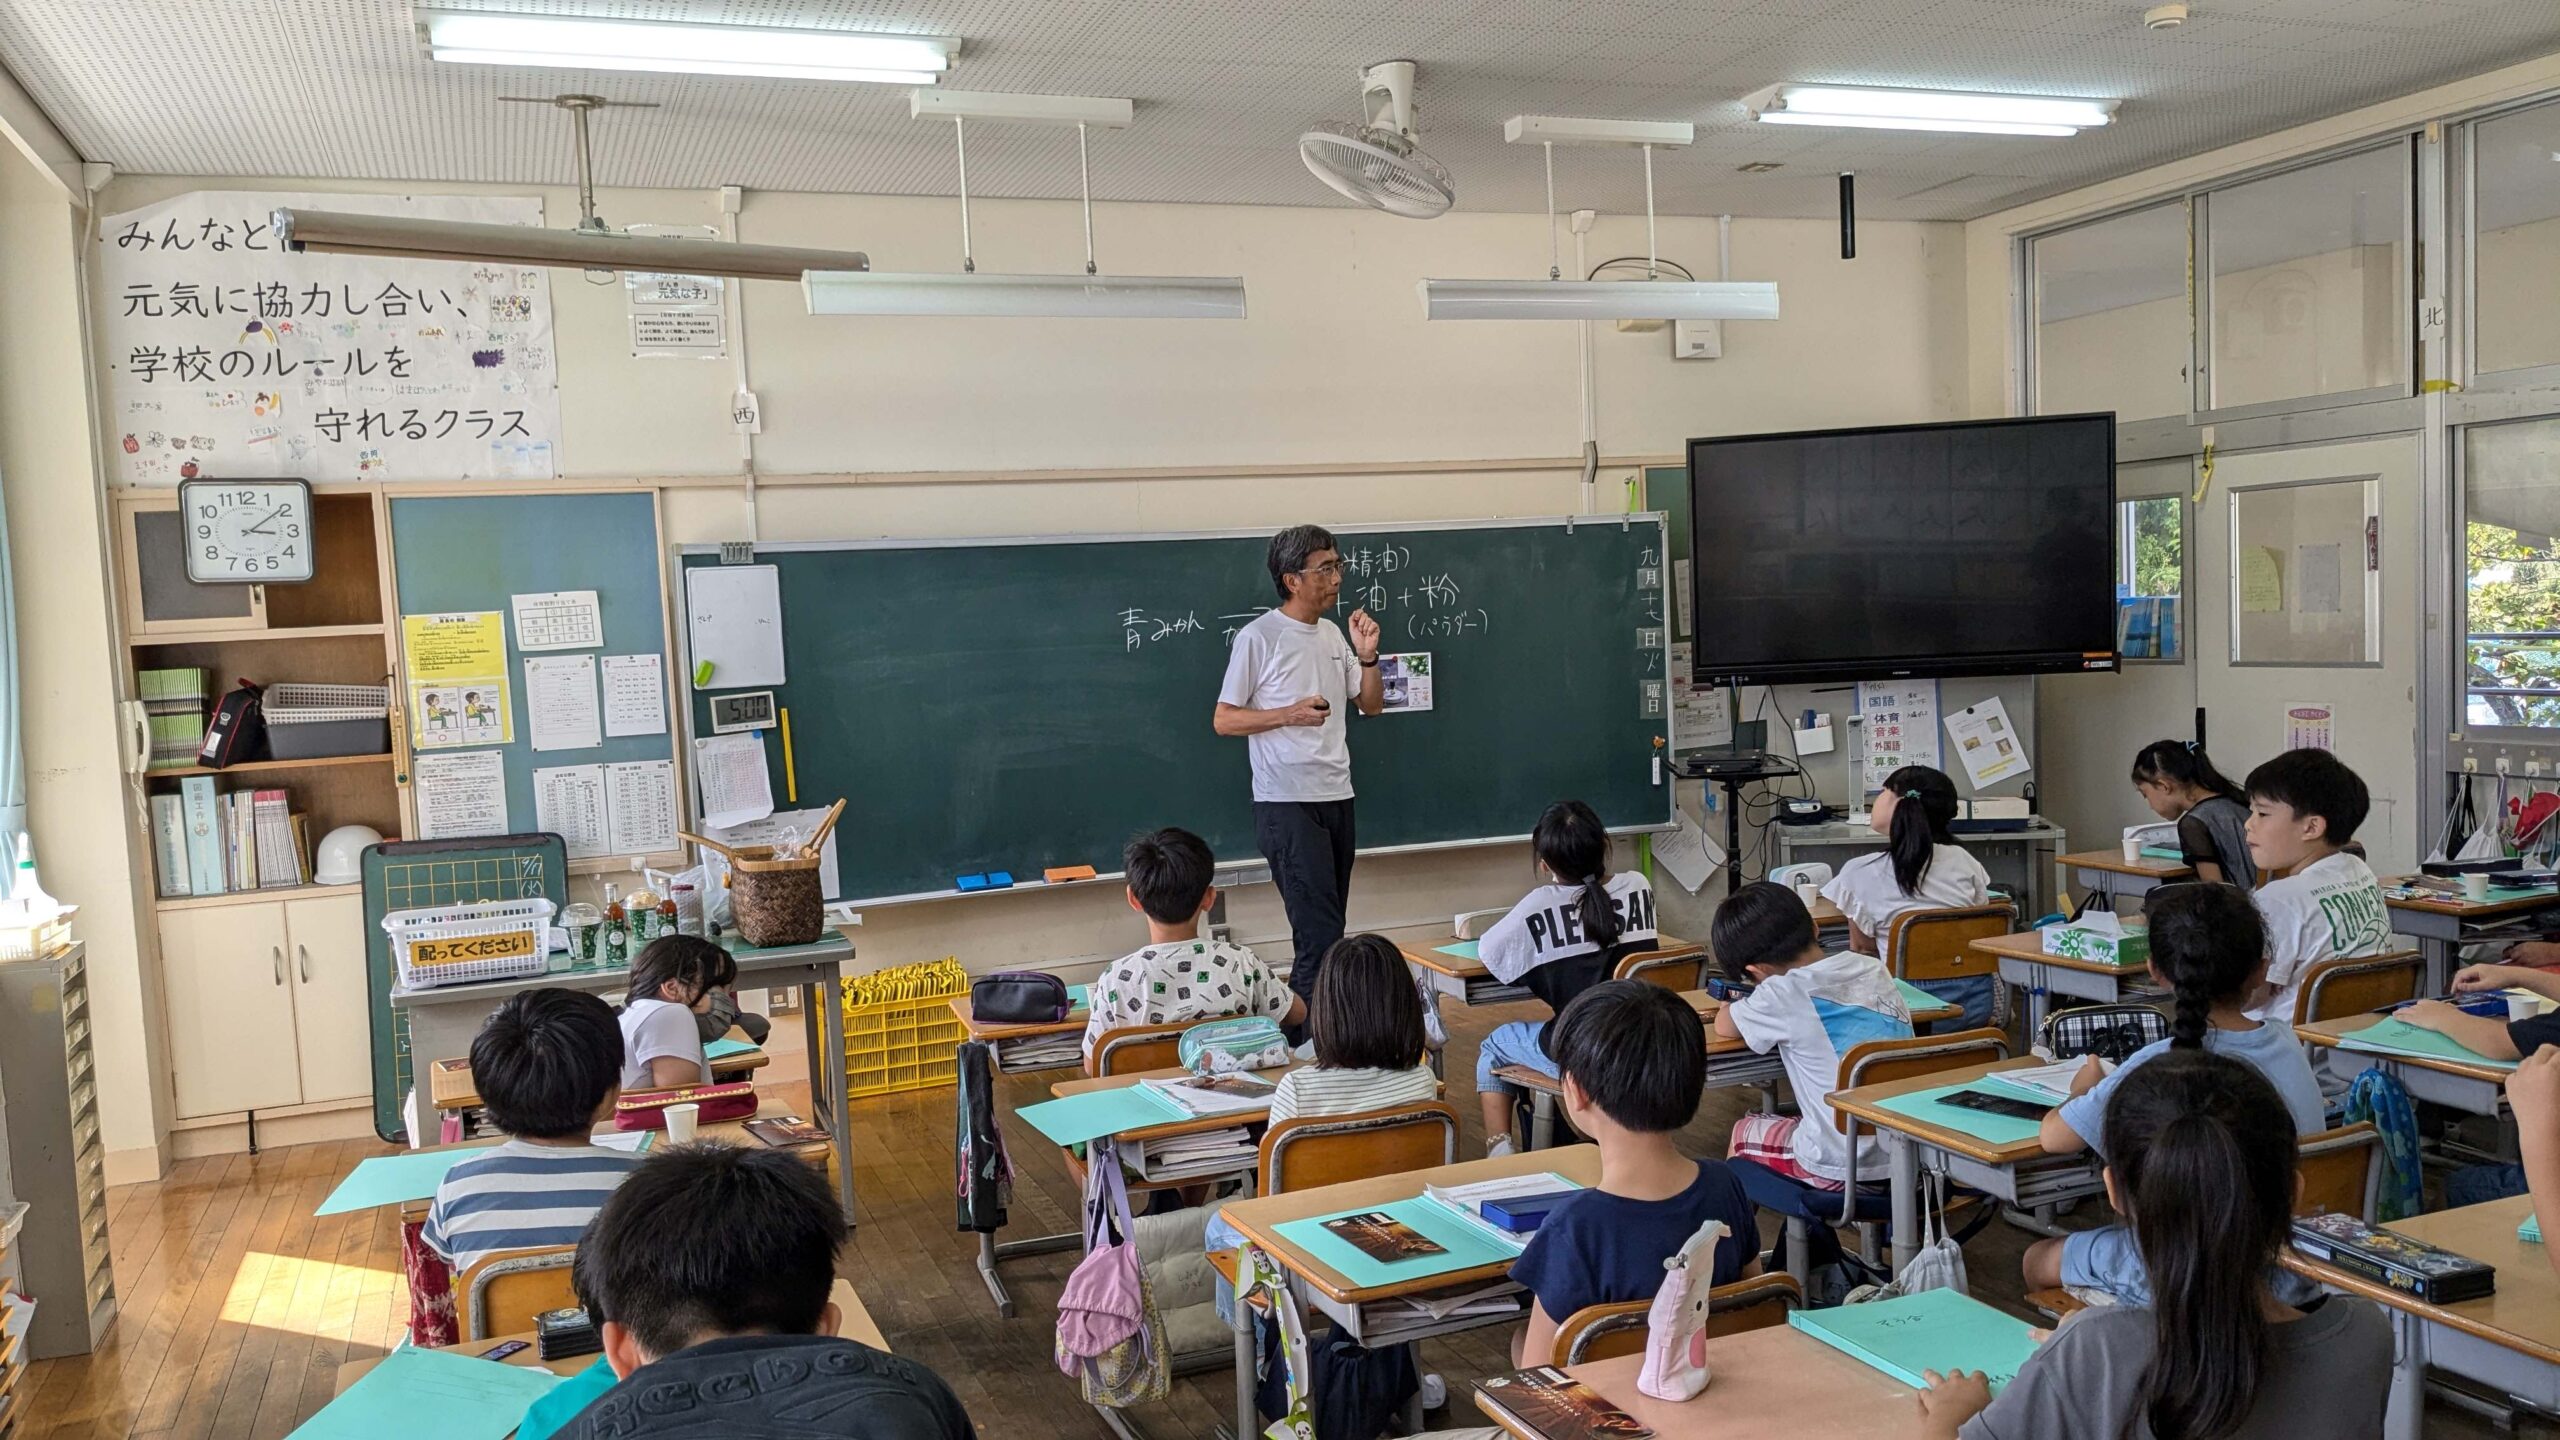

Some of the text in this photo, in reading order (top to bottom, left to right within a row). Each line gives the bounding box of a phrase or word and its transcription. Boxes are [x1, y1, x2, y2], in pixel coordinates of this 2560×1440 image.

[117, 217, 304, 253] みんなと
[122, 281, 468, 319] 元気に協力し合い、
[2424, 306, 2444, 327] 北
[129, 345, 413, 384] 学校のルールを
[733, 406, 755, 425] 西
[313, 407, 531, 443] 守れるクラス
[217, 491, 270, 506] 11 12 1
[198, 503, 293, 519] 10 2
[197, 524, 300, 539] 9 3
[205, 545, 296, 560] 8 4
[225, 556, 279, 573] 7 6 5
[1117, 607, 1206, 653] 青みかん
[1869, 695, 1896, 707] 国語
[1874, 712, 1900, 724] 体育
[1874, 726, 1900, 737] 音楽
[1874, 741, 1901, 752] 外国語
[1873, 755, 1900, 767] 算数
[417, 935, 529, 963] 配ってください
